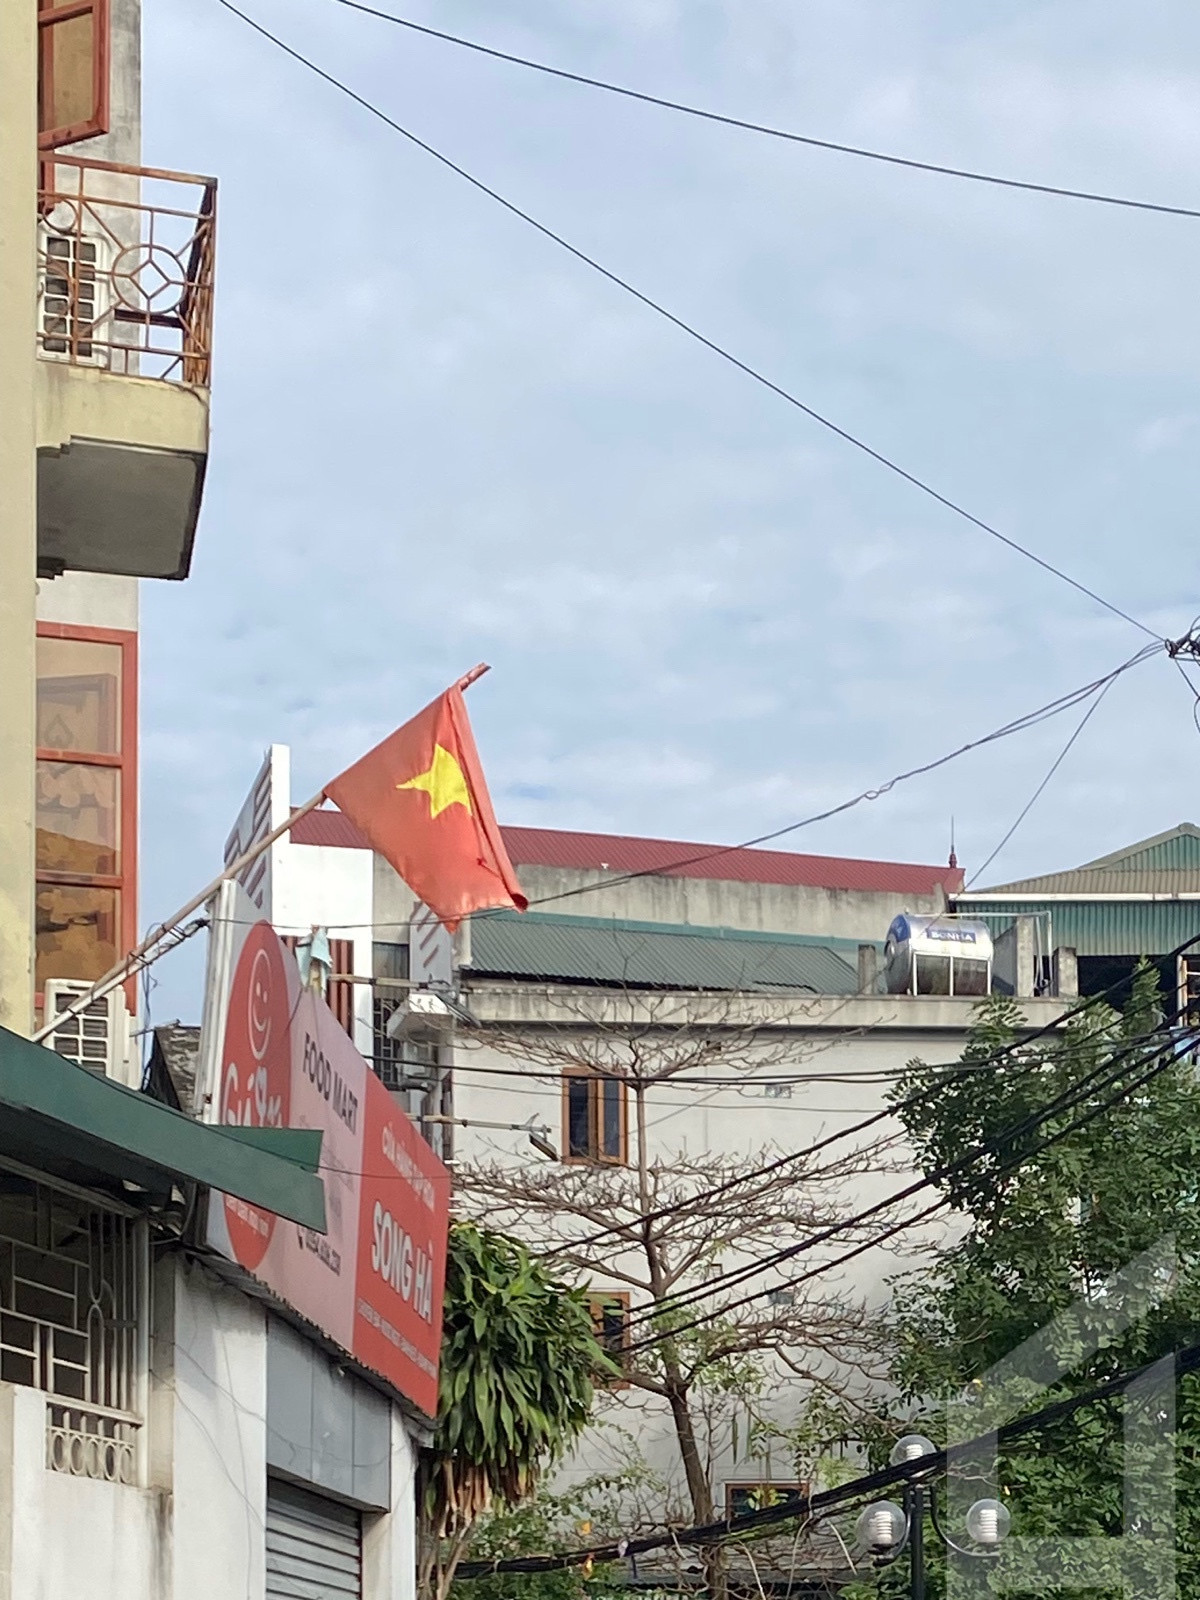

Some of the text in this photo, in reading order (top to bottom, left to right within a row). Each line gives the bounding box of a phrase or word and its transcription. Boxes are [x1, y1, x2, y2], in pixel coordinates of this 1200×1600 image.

[302, 1032, 359, 1136] FOOD MART
[371, 1200, 413, 1302] SONG
[412, 1238, 433, 1325] HÀ
